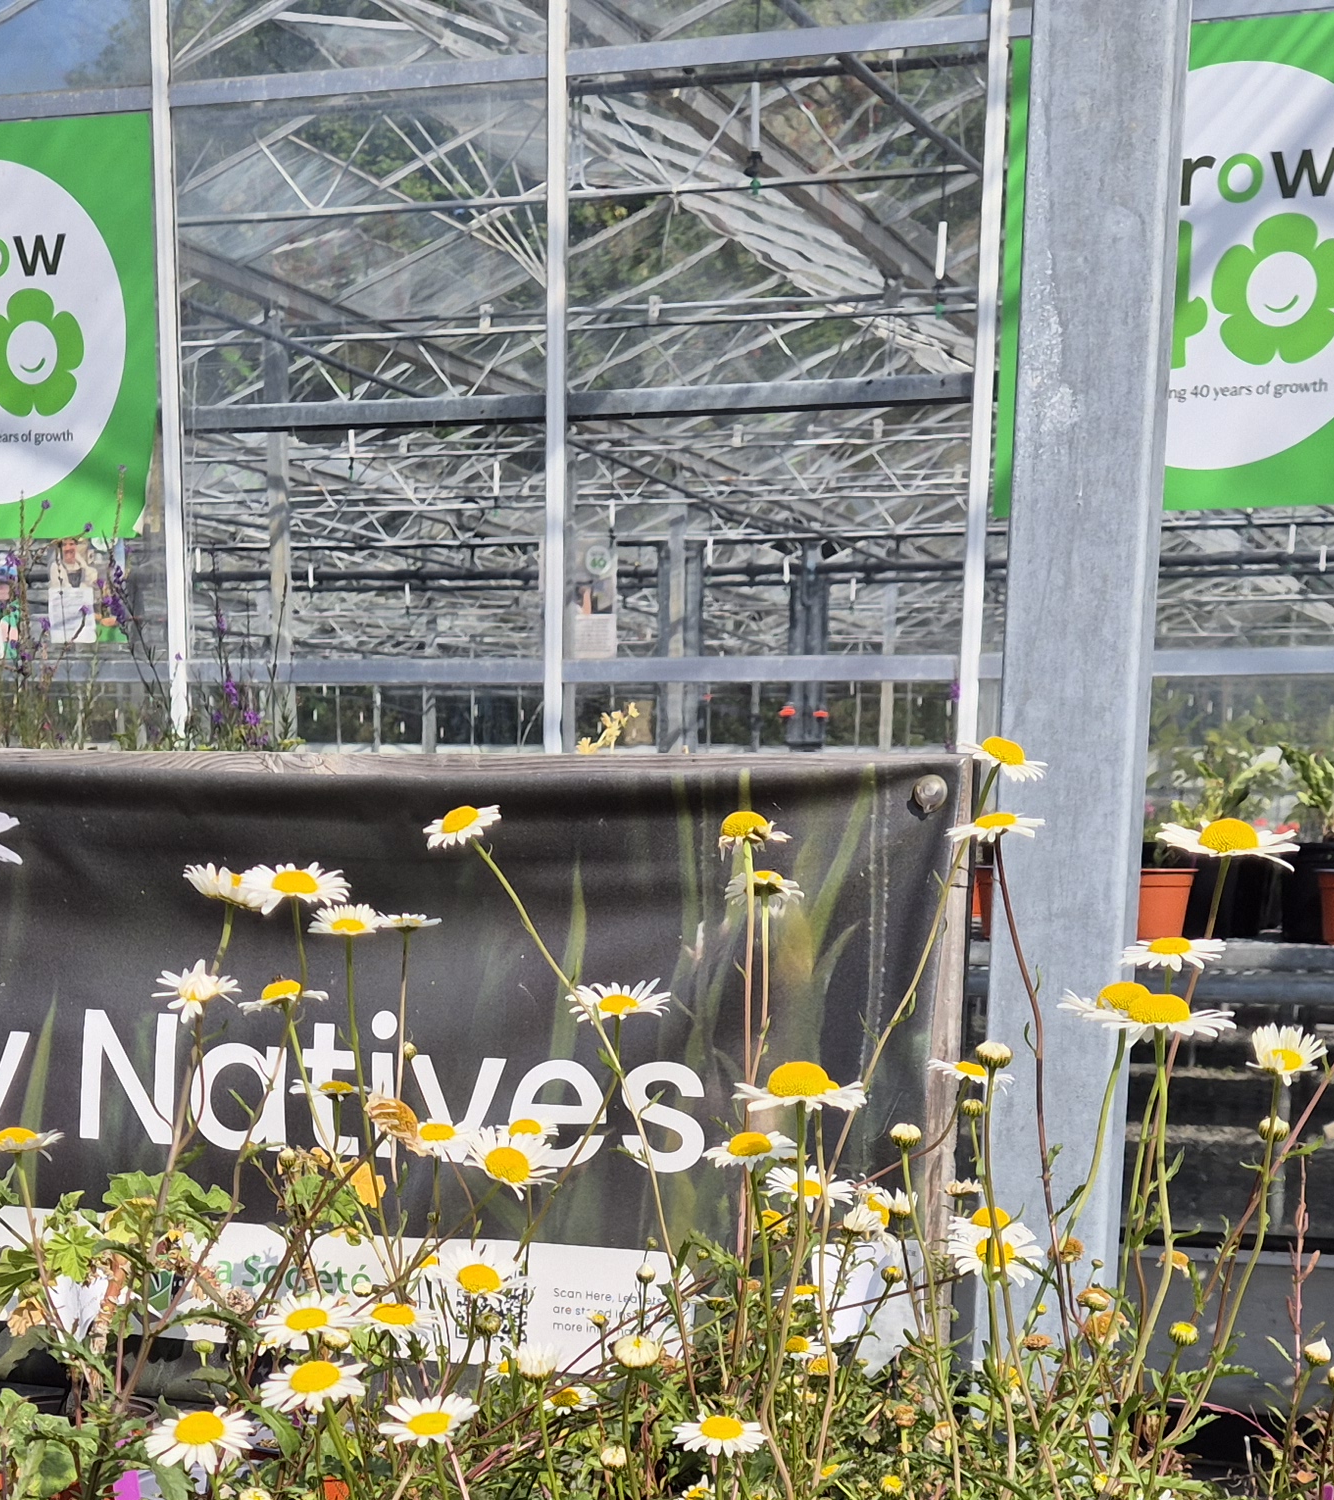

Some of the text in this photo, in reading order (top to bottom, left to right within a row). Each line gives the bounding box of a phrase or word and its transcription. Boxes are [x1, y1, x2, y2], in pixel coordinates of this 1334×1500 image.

[1191, 385, 1209, 399] 40
[1213, 382, 1252, 400] years
[1256, 381, 1271, 395] of
[1274, 378, 1328, 399] growth
[21, 430, 32, 442] of
[34, 430, 74, 445] growth
[79, 1009, 704, 1173] Natives
[553, 1288, 663, 1305] Scan Here, Leaets
[553, 1306, 571, 1315] are
[553, 1322, 582, 1332] more
